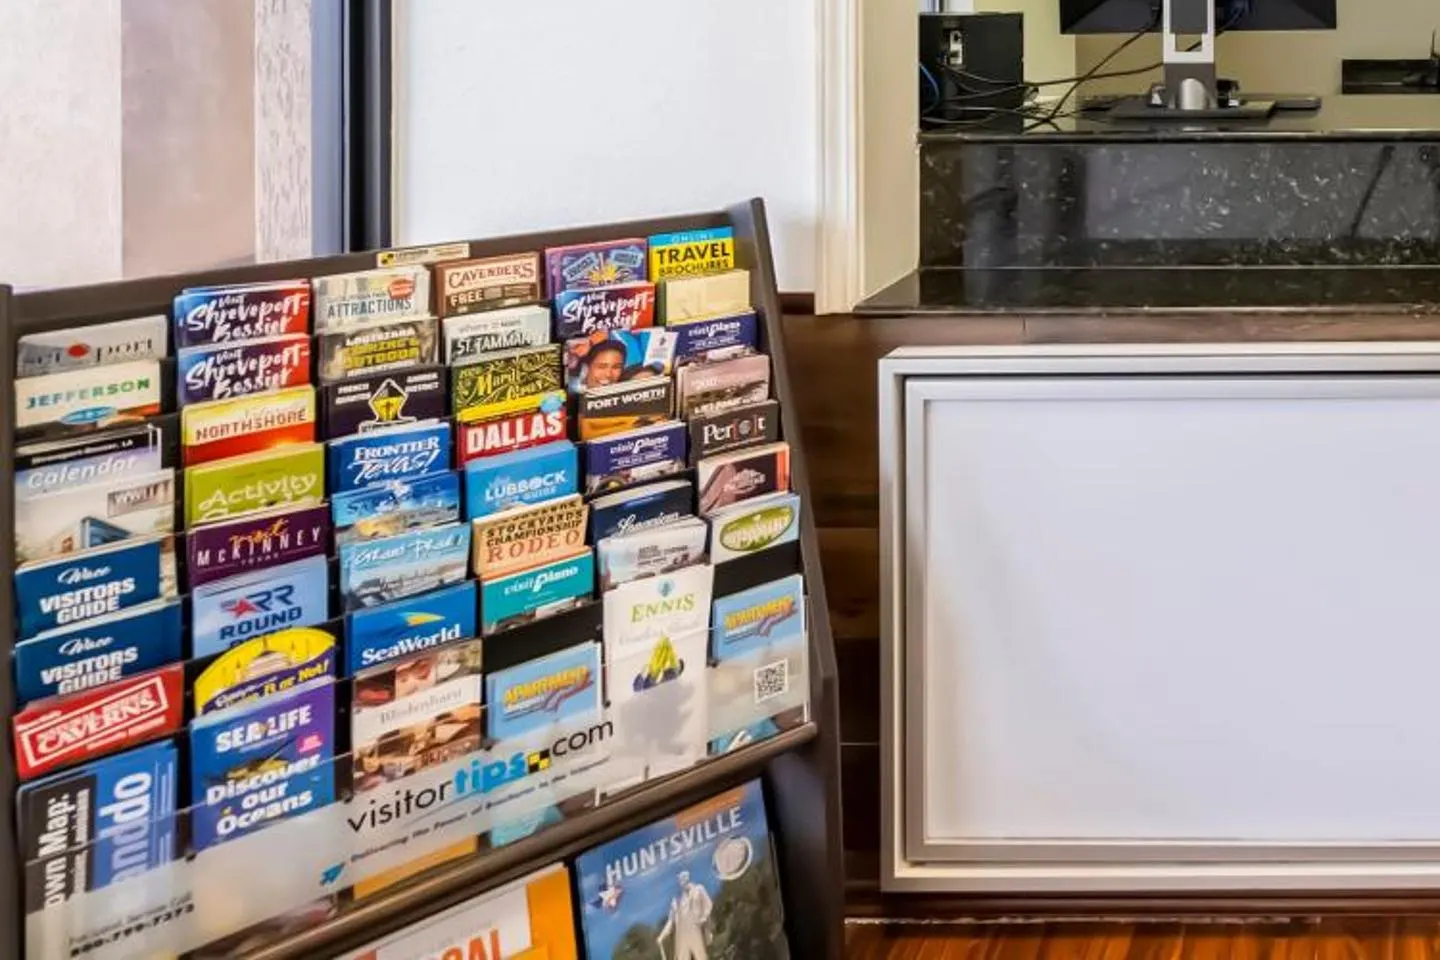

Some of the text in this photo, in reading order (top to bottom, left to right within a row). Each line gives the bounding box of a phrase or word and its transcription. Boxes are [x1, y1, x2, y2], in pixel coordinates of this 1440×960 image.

[657, 241, 731, 265] TRAVEL
[659, 258, 731, 278] BROCHURES
[327, 297, 412, 319] ATTRACTIONS
[450, 289, 484, 308] FREE
[26, 377, 151, 410] JEFFERSON
[586, 387, 666, 411] FORT WORTH
[195, 407, 308, 442] NORTHSHORE
[466, 411, 563, 455] DALLAS
[354, 435, 440, 462] FRONTIER
[27, 454, 139, 490] Calendar
[484, 470, 567, 501] LUBBOCK
[198, 472, 319, 512] Activity
[485, 511, 583, 538] STOCKYARDS
[486, 519, 582, 549] CHAMPIONSHIP
[487, 529, 581, 563] RODEO
[39, 577, 136, 614] VISITORS
[56, 595, 121, 625] GUIDE
[631, 593, 695, 624] ENNIS
[219, 606, 304, 640] ROUND
[361, 623, 462, 667] SeaWorld
[40, 646, 140, 685] VISITORS
[57, 665, 123, 696] GUIDE
[215, 721, 265, 753] SEA
[267, 704, 313, 735] LIFE
[605, 805, 744, 887] HUNTSVILLE
